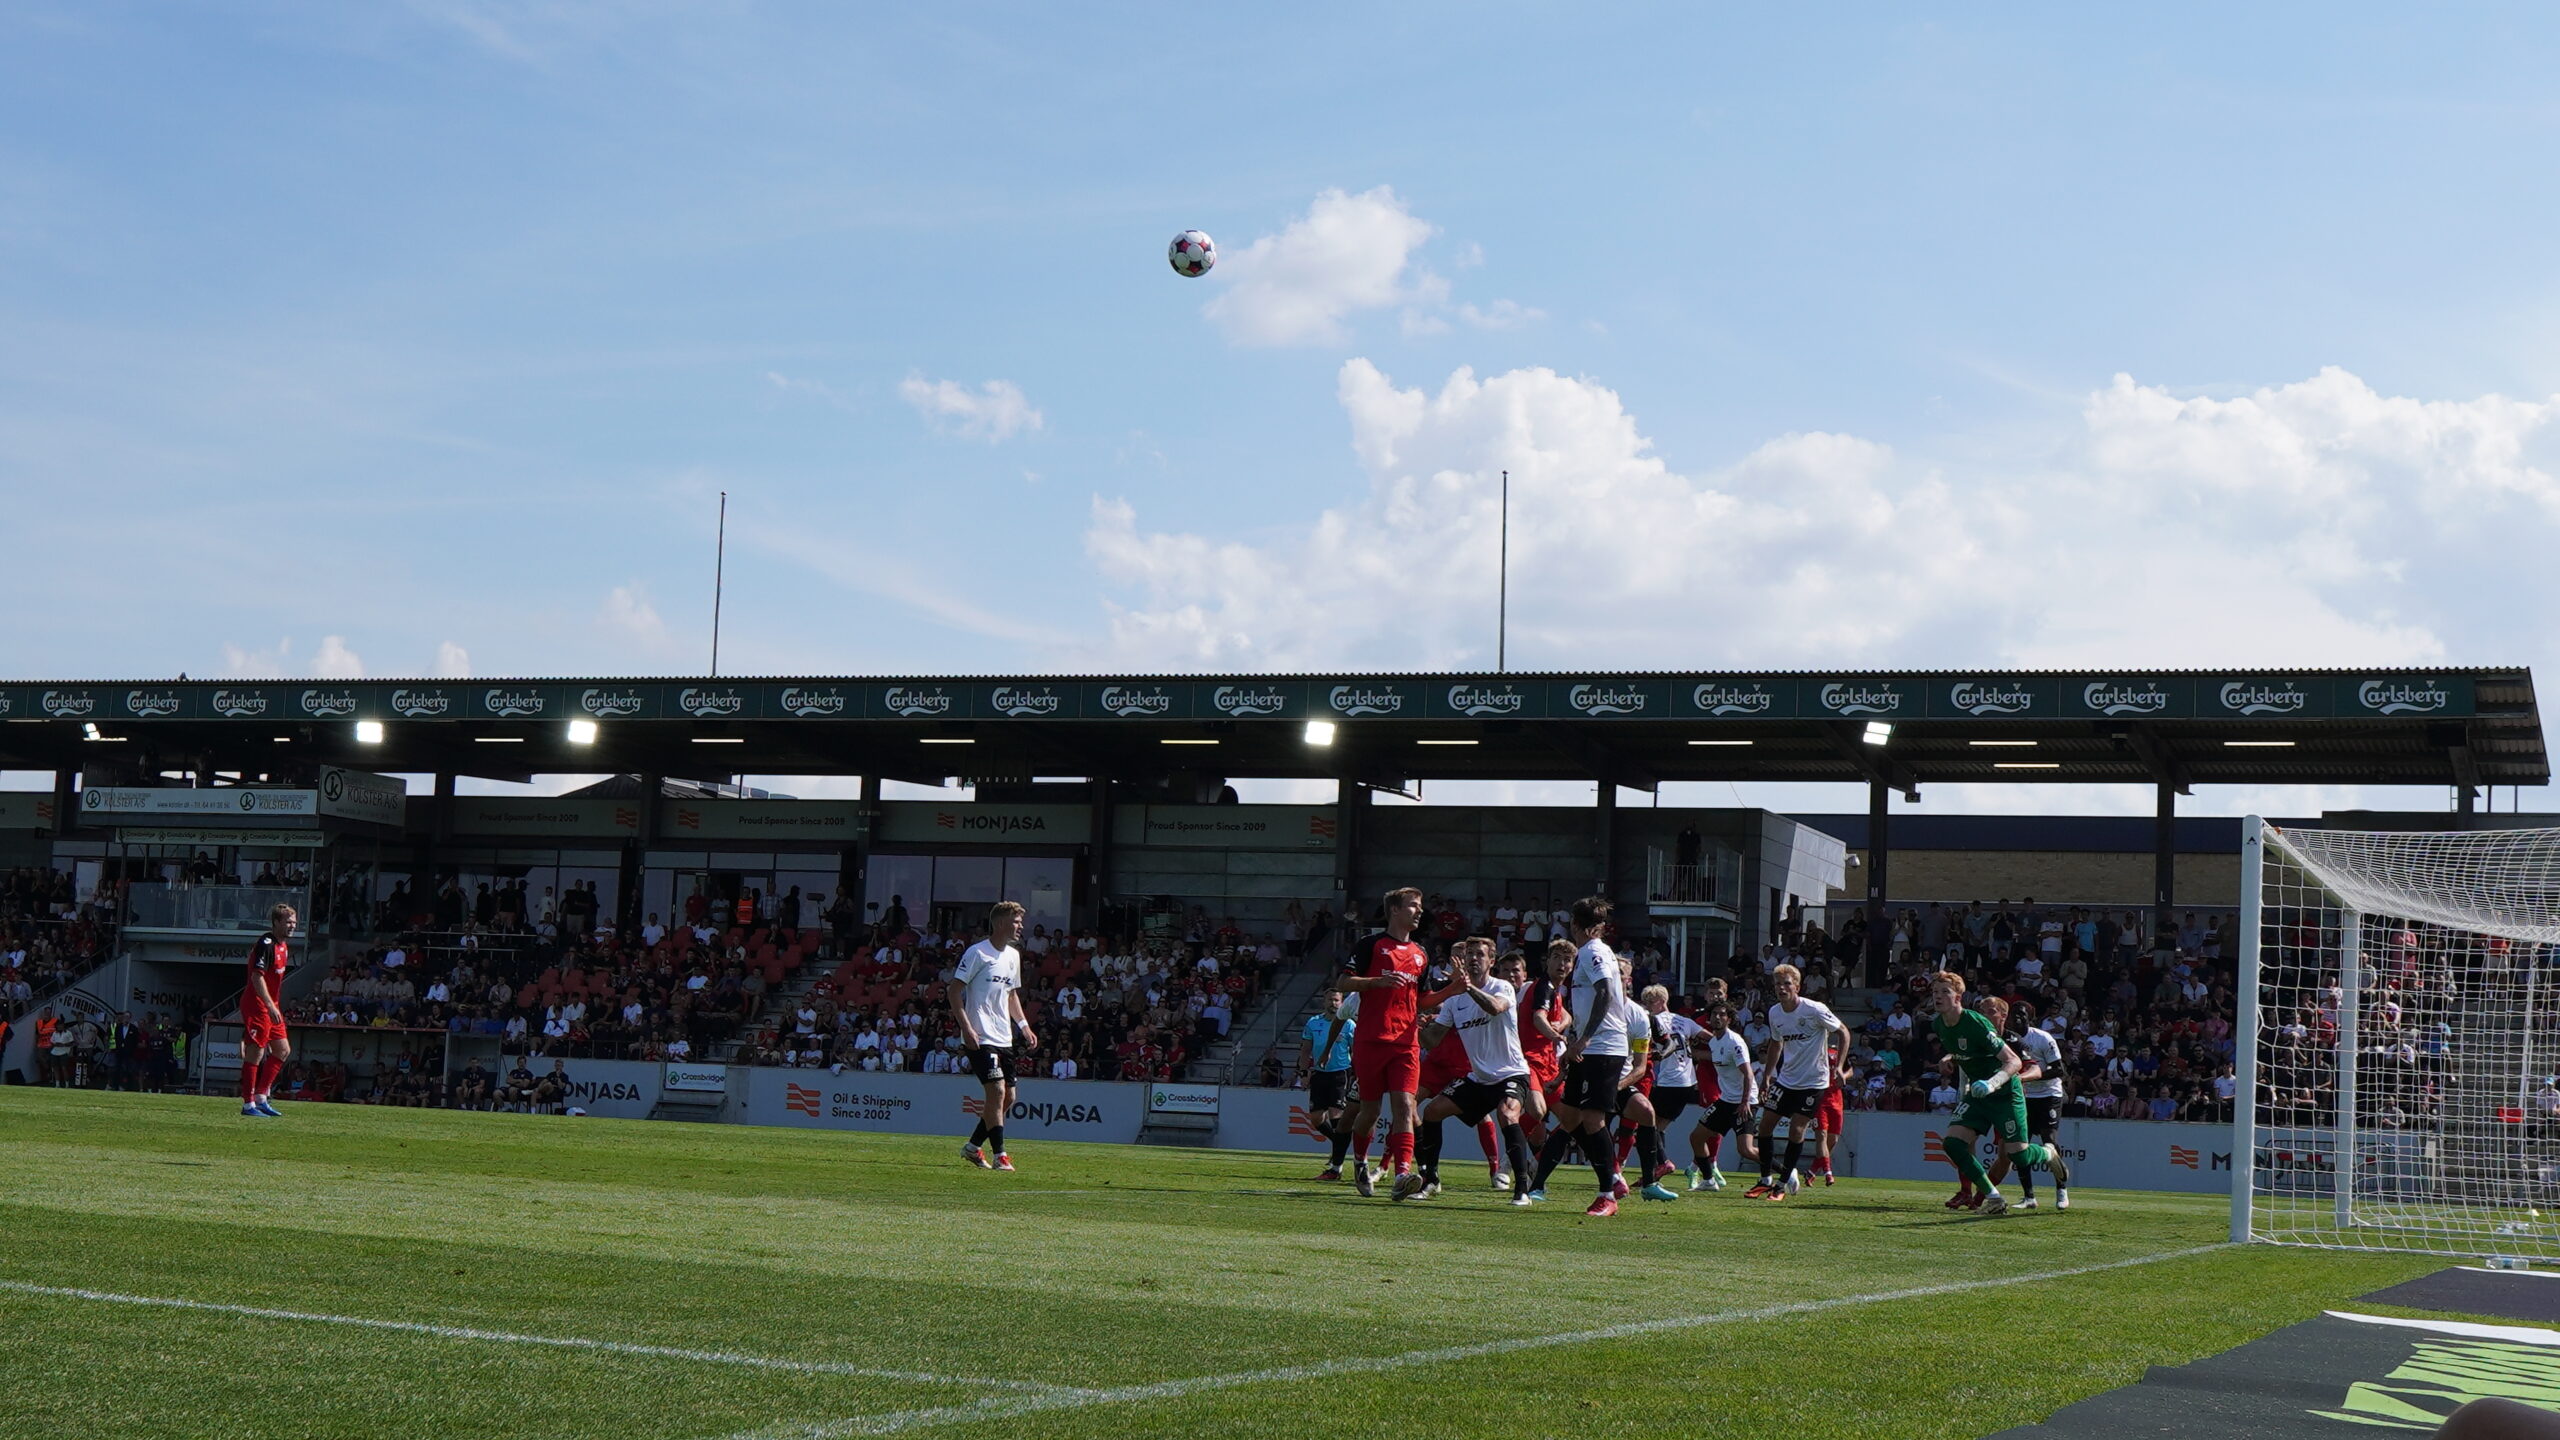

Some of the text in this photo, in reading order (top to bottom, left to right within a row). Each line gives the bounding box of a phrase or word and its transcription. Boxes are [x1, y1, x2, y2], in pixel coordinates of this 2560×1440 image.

[43, 691, 93, 716] Carlsberg
[127, 691, 178, 716] Carlsberg
[213, 691, 266, 716] Carlsberg
[302, 690, 355, 716] Carlsberg
[392, 690, 448, 716] Carlsberg
[486, 690, 543, 716] Carlsberg
[582, 690, 640, 716] Carlsberg
[680, 689, 741, 716] Carlsberg
[782, 689, 843, 716] Carlsberg
[886, 688, 949, 716] Carlsberg
[992, 688, 1057, 716] Carlsberg
[1102, 687, 1168, 716] Carlsberg
[1214, 687, 1283, 716] Carlsberg
[1330, 687, 1401, 716] Carlsberg
[1448, 686, 1521, 716] Carlsberg
[1570, 685, 1644, 715] Carlsberg
[1694, 685, 1769, 715] Carlsberg
[1821, 684, 1899, 715] Carlsberg
[1951, 684, 2030, 715] Carlsberg
[2084, 683, 2165, 715] Carlsberg
[2221, 683, 2303, 715] Carlsberg
[2358, 680, 2446, 716] Carlsberg
[479, 812, 502, 821] Proud
[536, 812, 558, 822] Since
[738, 816, 763, 825] Proud
[764, 816, 798, 827] Sponsor
[799, 816, 822, 825] Since
[962, 816, 1046, 834] MONJASA
[1147, 821, 1267, 832] Proud Sponsor Since 2009
[681, 1072, 726, 1083] Crossbridge
[563, 1081, 641, 1104] ONJASA
[832, 1092, 912, 1111] Oil & Shipping
[1168, 1093, 1218, 1105] Crossbridge
[831, 1106, 892, 1121] Since 2002
[1004, 1101, 1103, 1127] ONJASA
